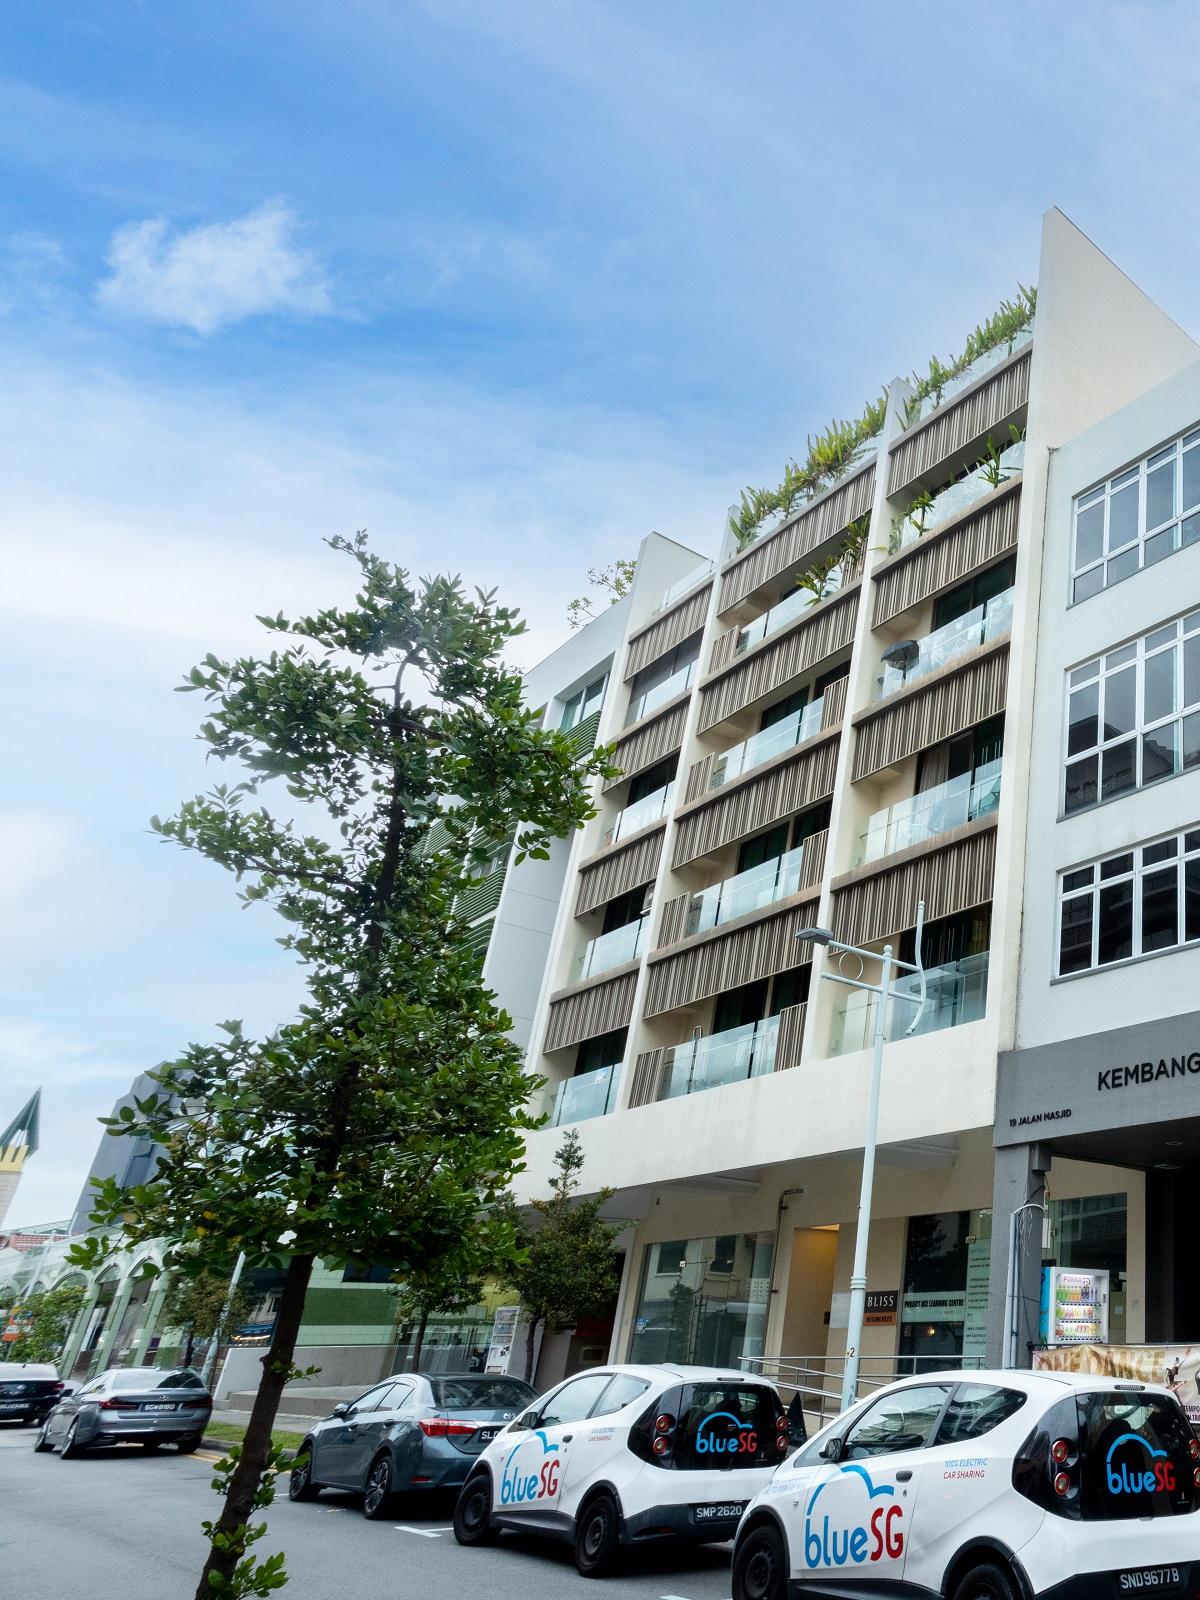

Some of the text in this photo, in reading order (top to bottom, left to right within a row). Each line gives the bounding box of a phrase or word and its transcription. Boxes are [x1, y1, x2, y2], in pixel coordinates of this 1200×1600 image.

[1018, 1113, 1043, 1127] JALAN
[1043, 1108, 1073, 1122] MASJID
[867, 1295, 895, 1308] BLISS
[696, 1430, 758, 1454] blueSG
[500, 1459, 561, 1505] blueSG
[943, 1469, 985, 1480] CAR SHARING
[1106, 1461, 1176, 1495] blueSG
[696, 1505, 746, 1519] SMP2620
[804, 1504, 904, 1569] blueSG
[1120, 1567, 1180, 1589] SND9677B
